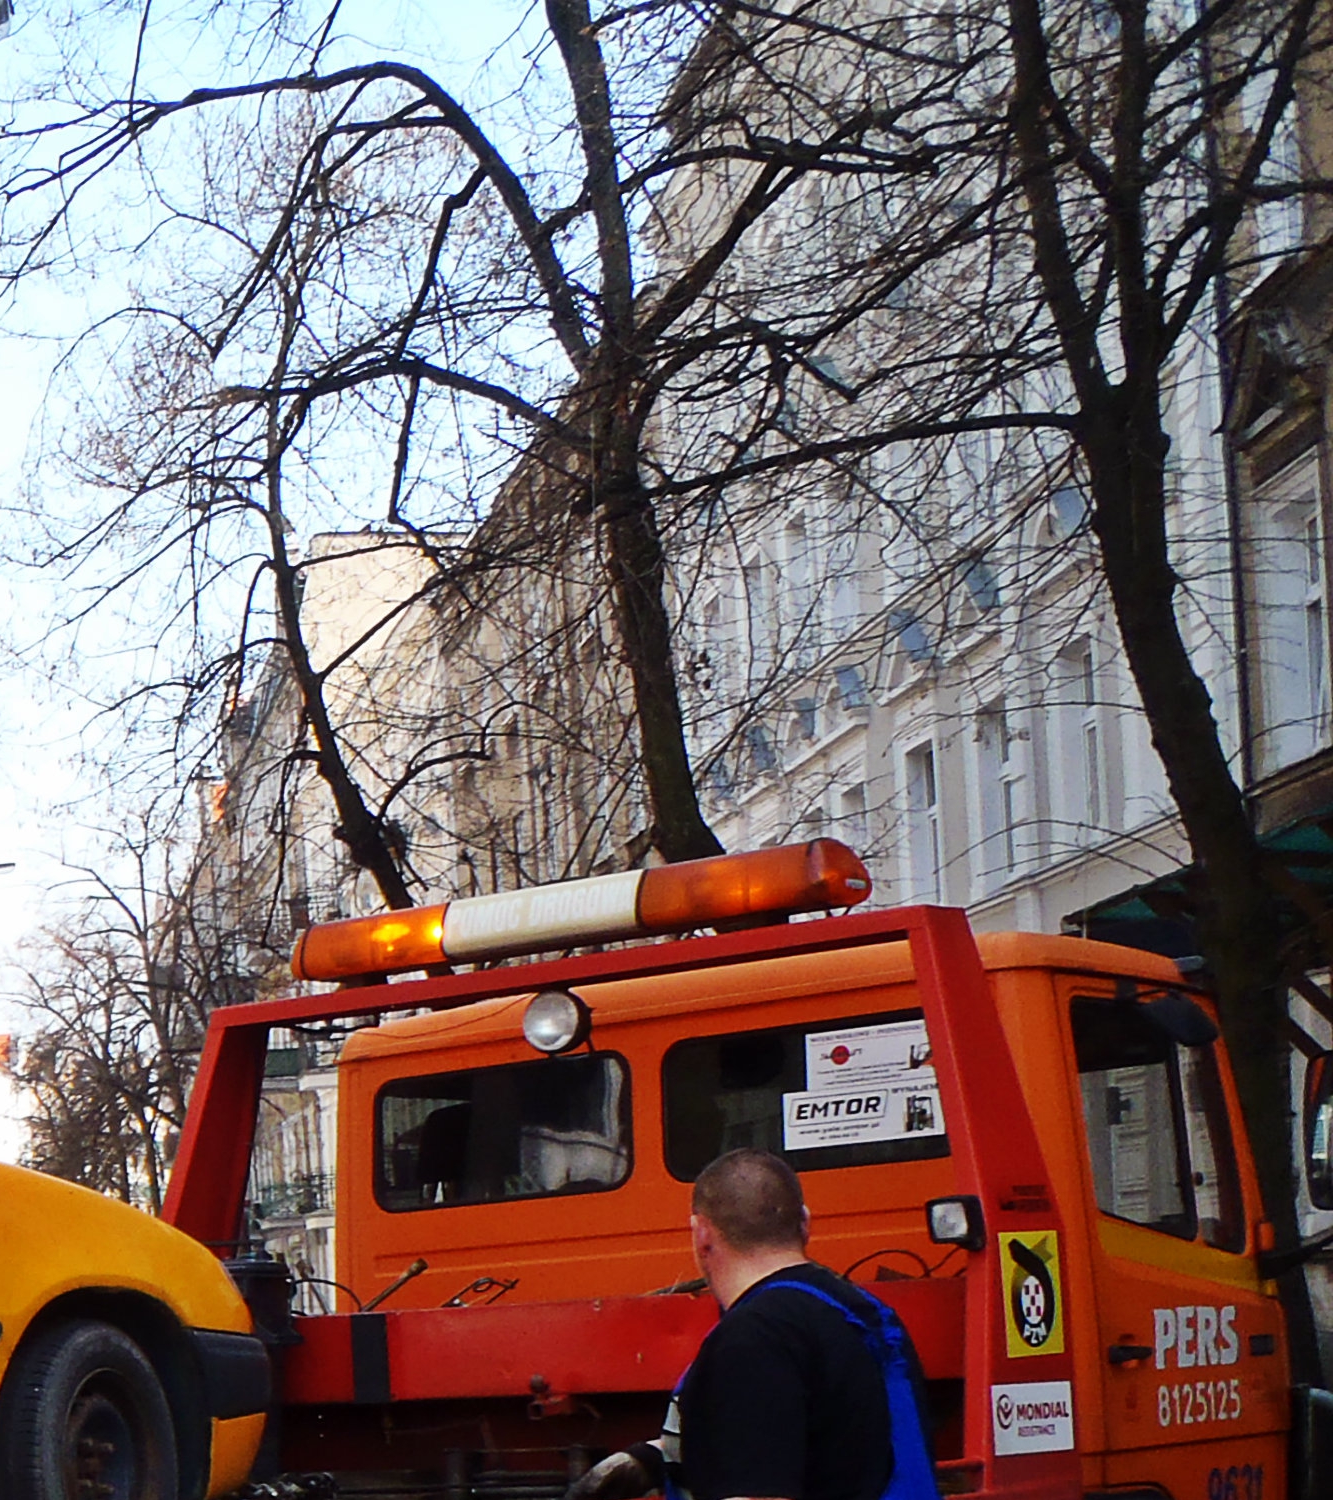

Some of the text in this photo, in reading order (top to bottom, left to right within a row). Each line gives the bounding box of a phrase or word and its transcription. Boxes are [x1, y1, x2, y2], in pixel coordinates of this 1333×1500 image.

[795, 1096, 881, 1121] EMTOR
[1154, 1305, 1240, 1370] PERS
[1017, 1401, 1069, 1420] MONDIAL
[1157, 1378, 1241, 1427] 8125125
